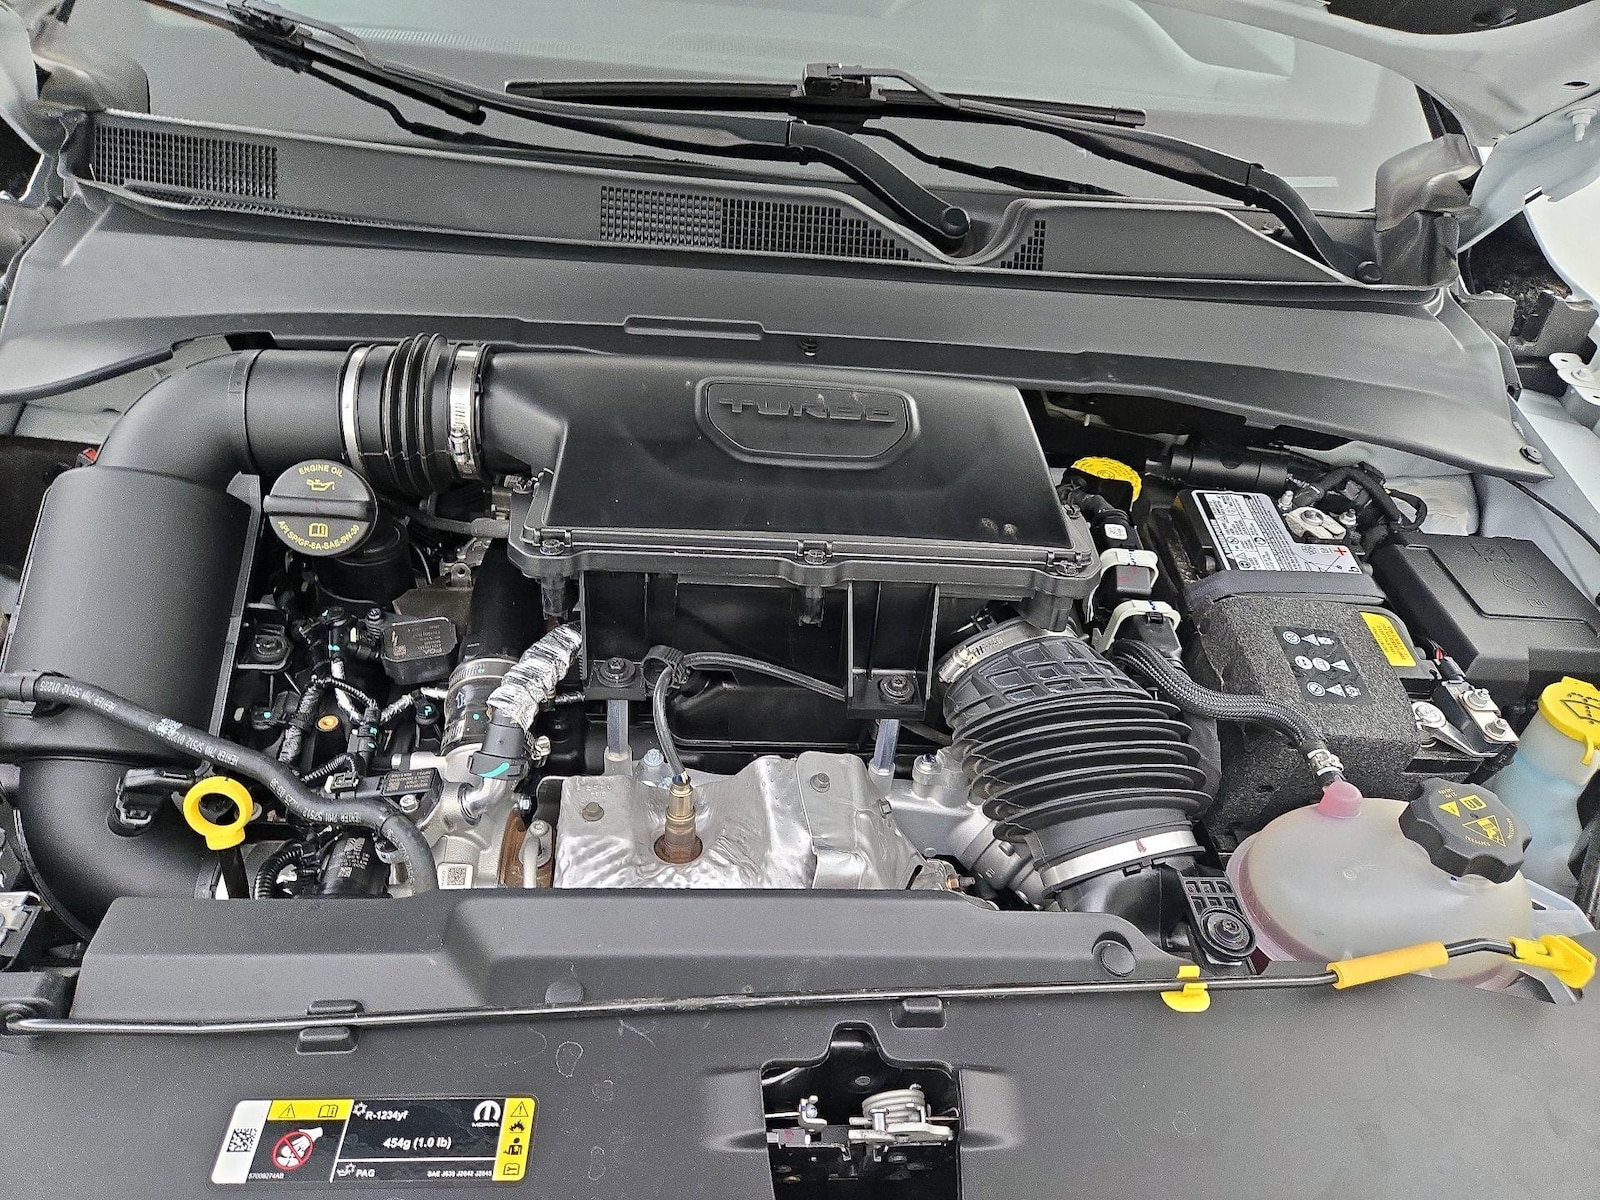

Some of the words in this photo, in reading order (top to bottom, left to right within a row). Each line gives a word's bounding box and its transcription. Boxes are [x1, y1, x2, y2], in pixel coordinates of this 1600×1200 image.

[718, 398, 898, 424] TURBO
[298, 463, 330, 476] ENGINE
[331, 465, 344, 478] OIL
[278, 520, 291, 534] API
[185, 735, 205, 753] 57512
[217, 750, 240, 767] HEATER
[302, 806, 323, 822] 57512
[365, 1110, 409, 1121] R-1234yf
[382, 1137, 411, 1150] 454g
[413, 1137, 434, 1150] (1.0
[436, 1136, 452, 1150] lb)
[355, 1168, 376, 1178] PAG
[427, 1170, 440, 1178] SAE
